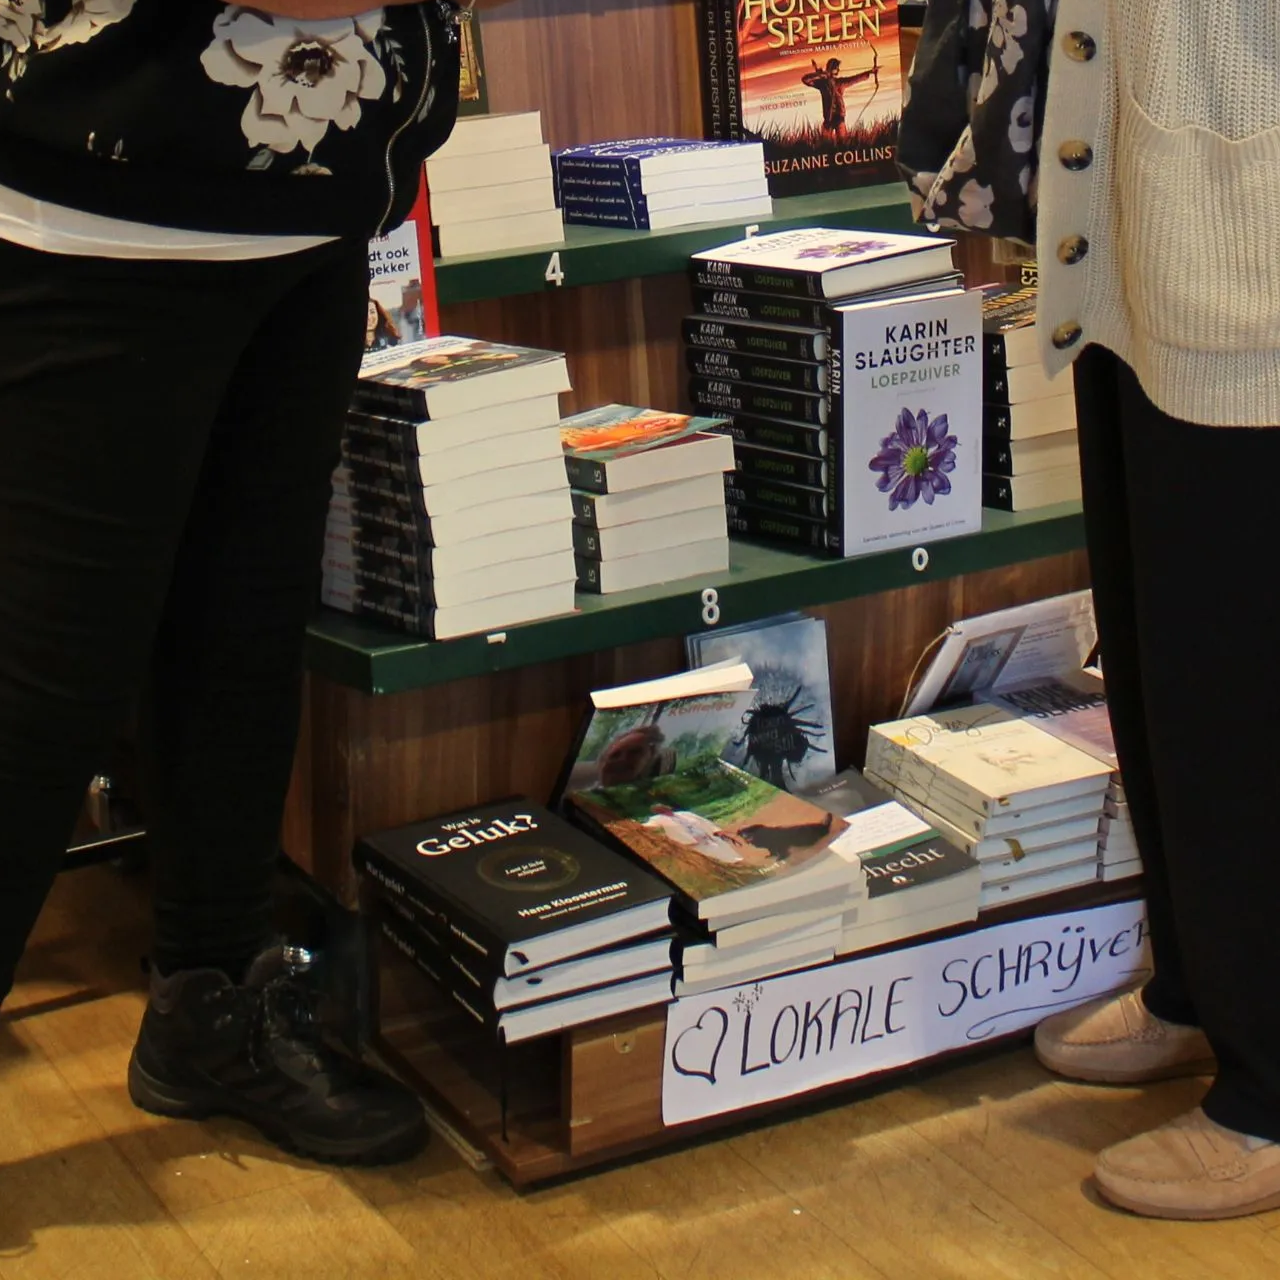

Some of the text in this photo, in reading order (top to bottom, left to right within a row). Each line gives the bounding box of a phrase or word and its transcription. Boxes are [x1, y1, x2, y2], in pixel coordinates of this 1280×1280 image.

[768, 9, 881, 49] SPELEN
[764, 147, 893, 175] SUZANNE COLLINS
[369, 262, 411, 279] gekker
[386, 247, 410, 260] ook
[545, 252, 565, 286] 4
[707, 261, 731, 273] KARIN
[713, 292, 738, 305] KARIN
[885, 318, 948, 343] KARIN
[855, 336, 976, 371] SLAUGHTER
[832, 348, 841, 395] KARIN
[871, 363, 961, 389] LOEPZUIVER
[700, 588, 721, 624] 8
[416, 814, 538, 857] Geluk?
[441, 818, 466, 832] Wat
[863, 847, 946, 881] hecht
[518, 902, 552, 918] Hans
[551, 880, 629, 909] Kloosterman
[740, 976, 913, 1076] LOKALE
